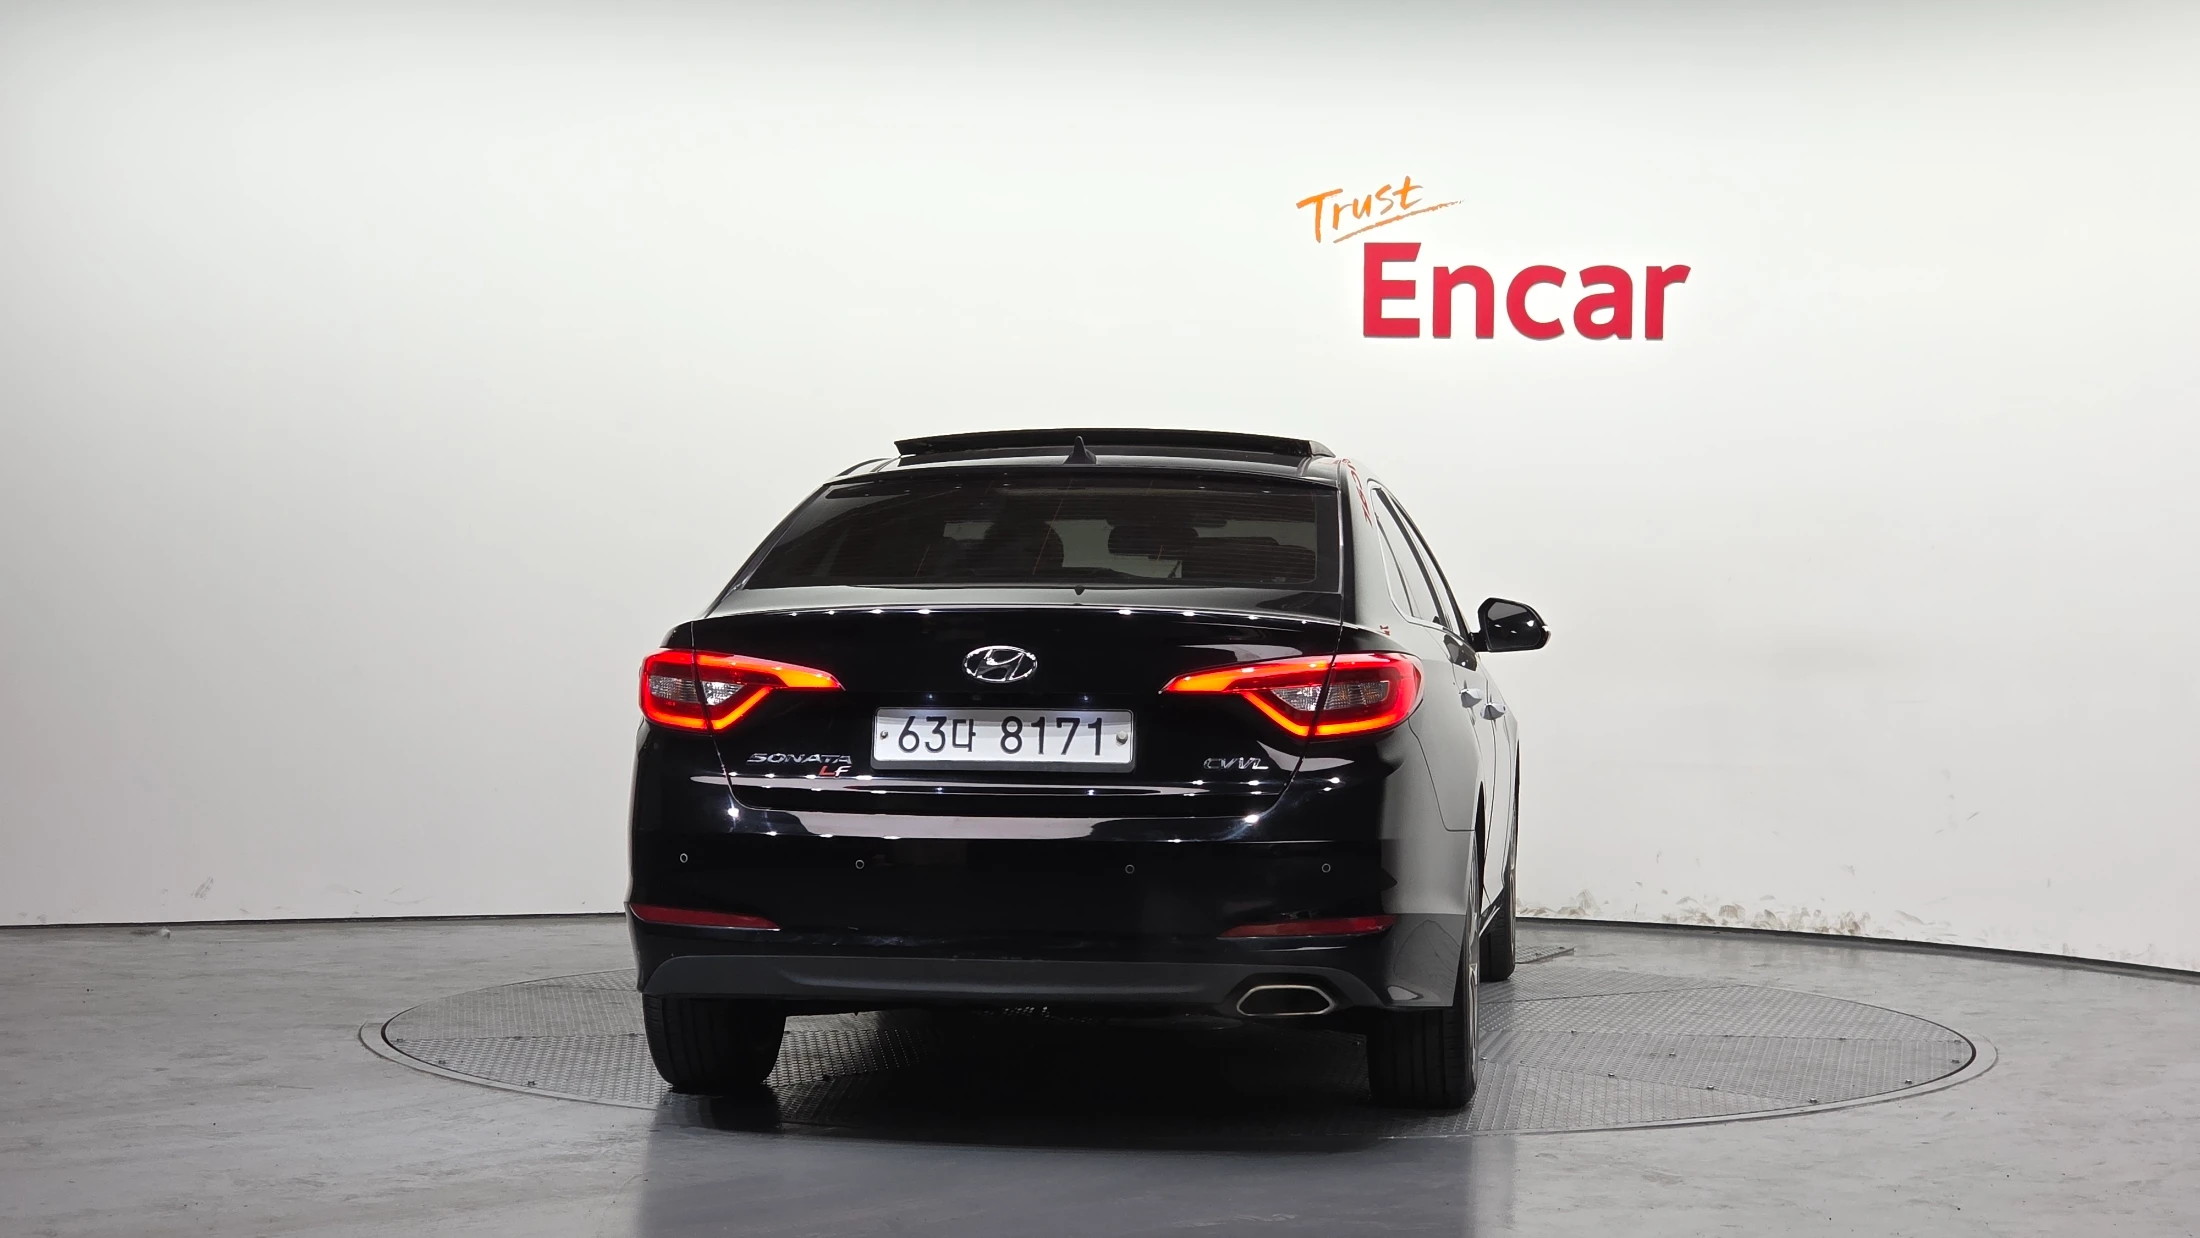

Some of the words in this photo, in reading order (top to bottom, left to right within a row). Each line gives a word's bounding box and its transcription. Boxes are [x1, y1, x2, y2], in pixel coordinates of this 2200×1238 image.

[1296, 175, 1424, 243] Trust
[1363, 242, 1691, 340] Encar
[898, 715, 976, 754] 63다
[1000, 715, 1103, 756] 8171
[746, 752, 852, 764] SONATA
[818, 765, 852, 777] LF
